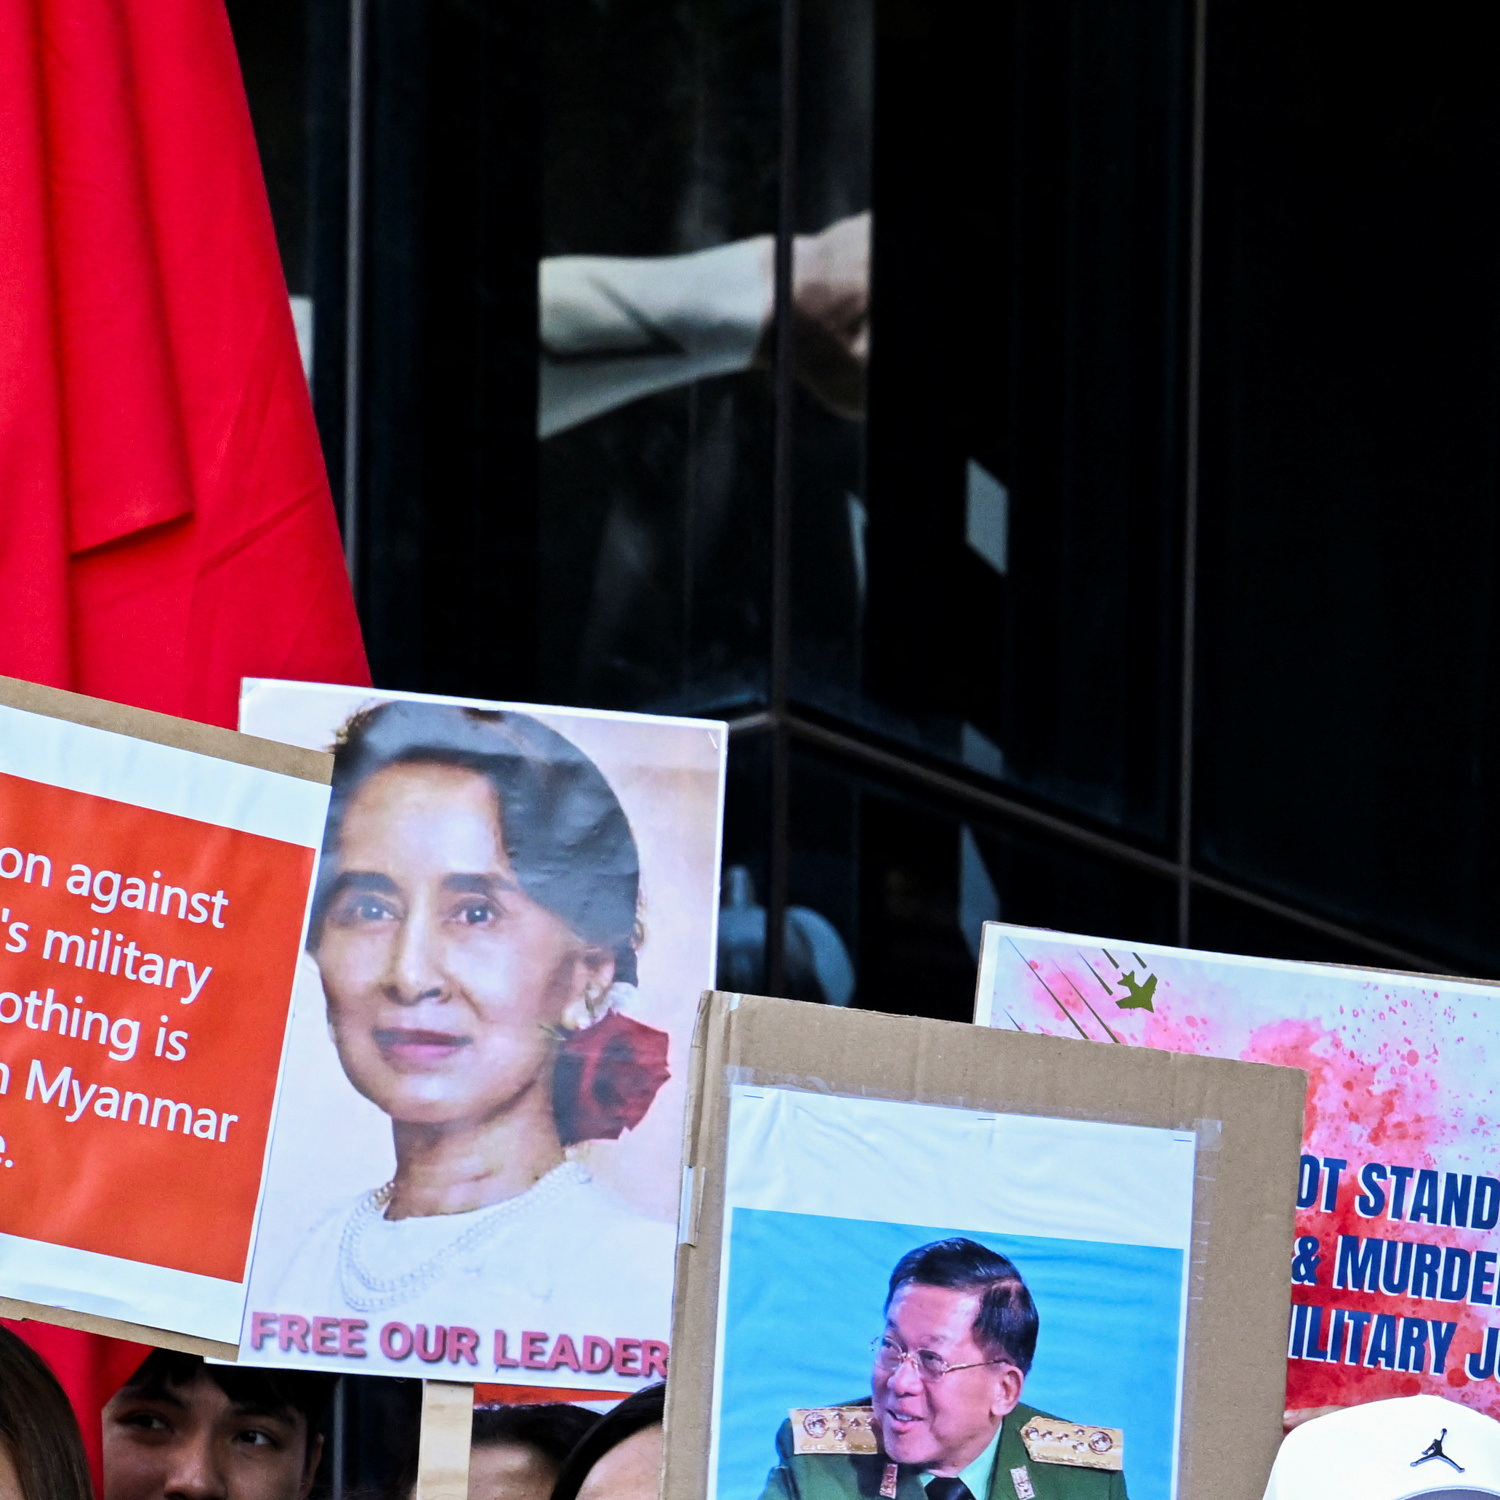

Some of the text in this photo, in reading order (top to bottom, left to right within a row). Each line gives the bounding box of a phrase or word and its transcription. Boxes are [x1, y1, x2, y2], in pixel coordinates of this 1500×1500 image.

[66, 863, 229, 929] against
[42, 927, 213, 1005] military
[154, 1014, 189, 1062] is
[25, 1059, 239, 1143] Myanmar
[1359, 1163, 1500, 1229] STAND
[251, 1311, 669, 1378] FREE OUR LEADER
[1288, 1304, 1457, 1374] ILITARY
